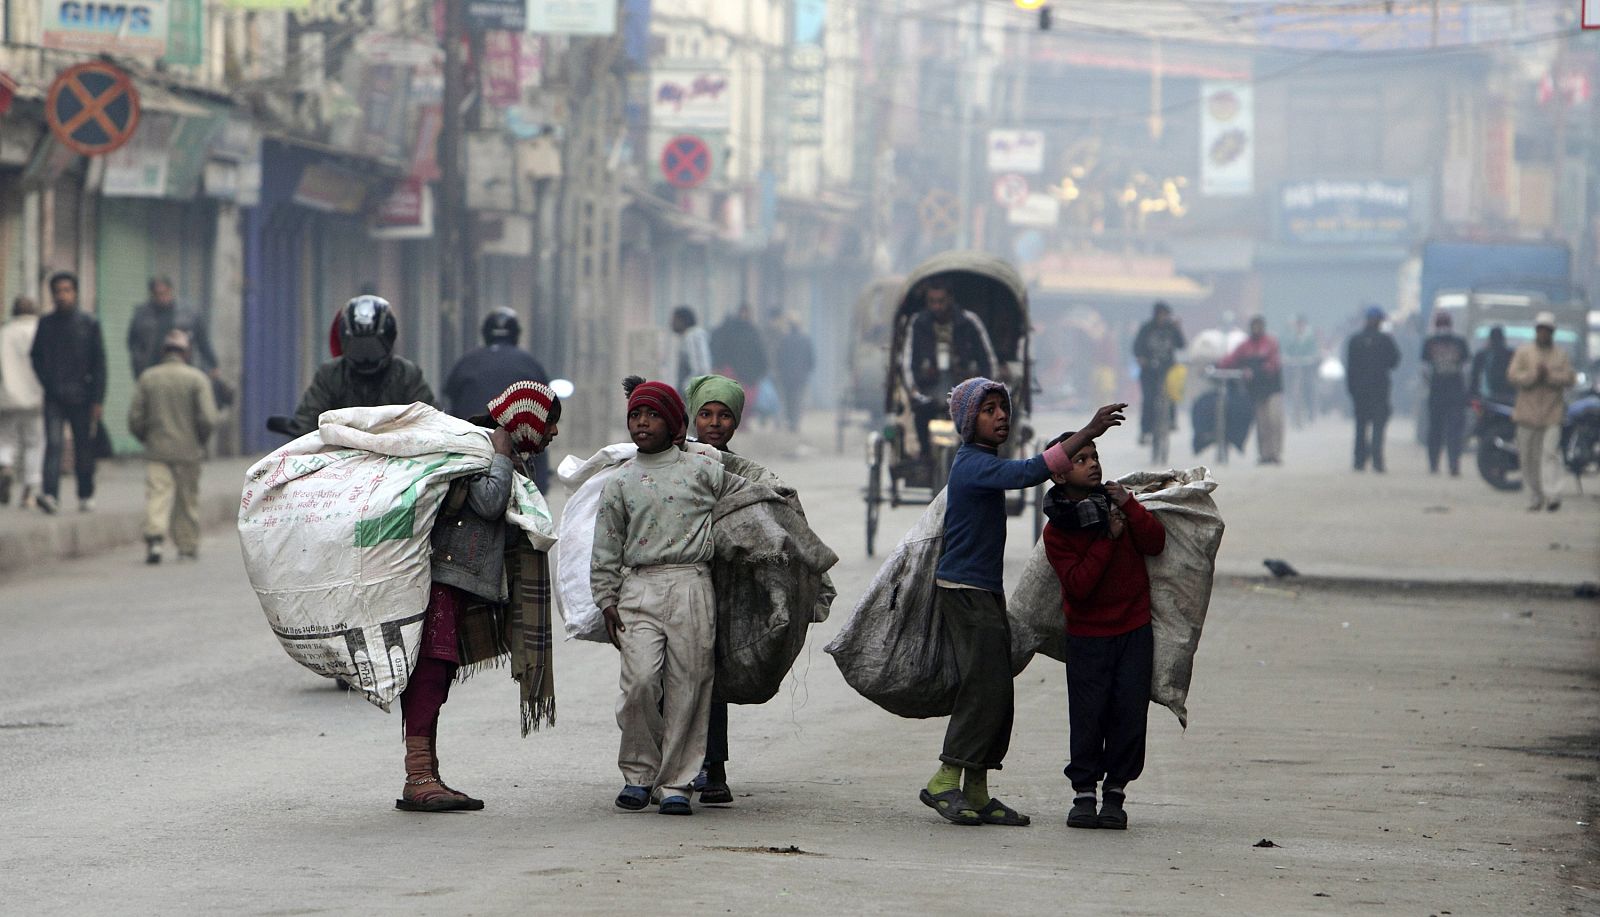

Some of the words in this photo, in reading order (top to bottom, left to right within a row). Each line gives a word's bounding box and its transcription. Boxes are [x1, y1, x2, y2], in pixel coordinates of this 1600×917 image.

[59, 1, 151, 31] GIMS
[302, 624, 330, 634] Weight
[331, 622, 348, 631] Net
